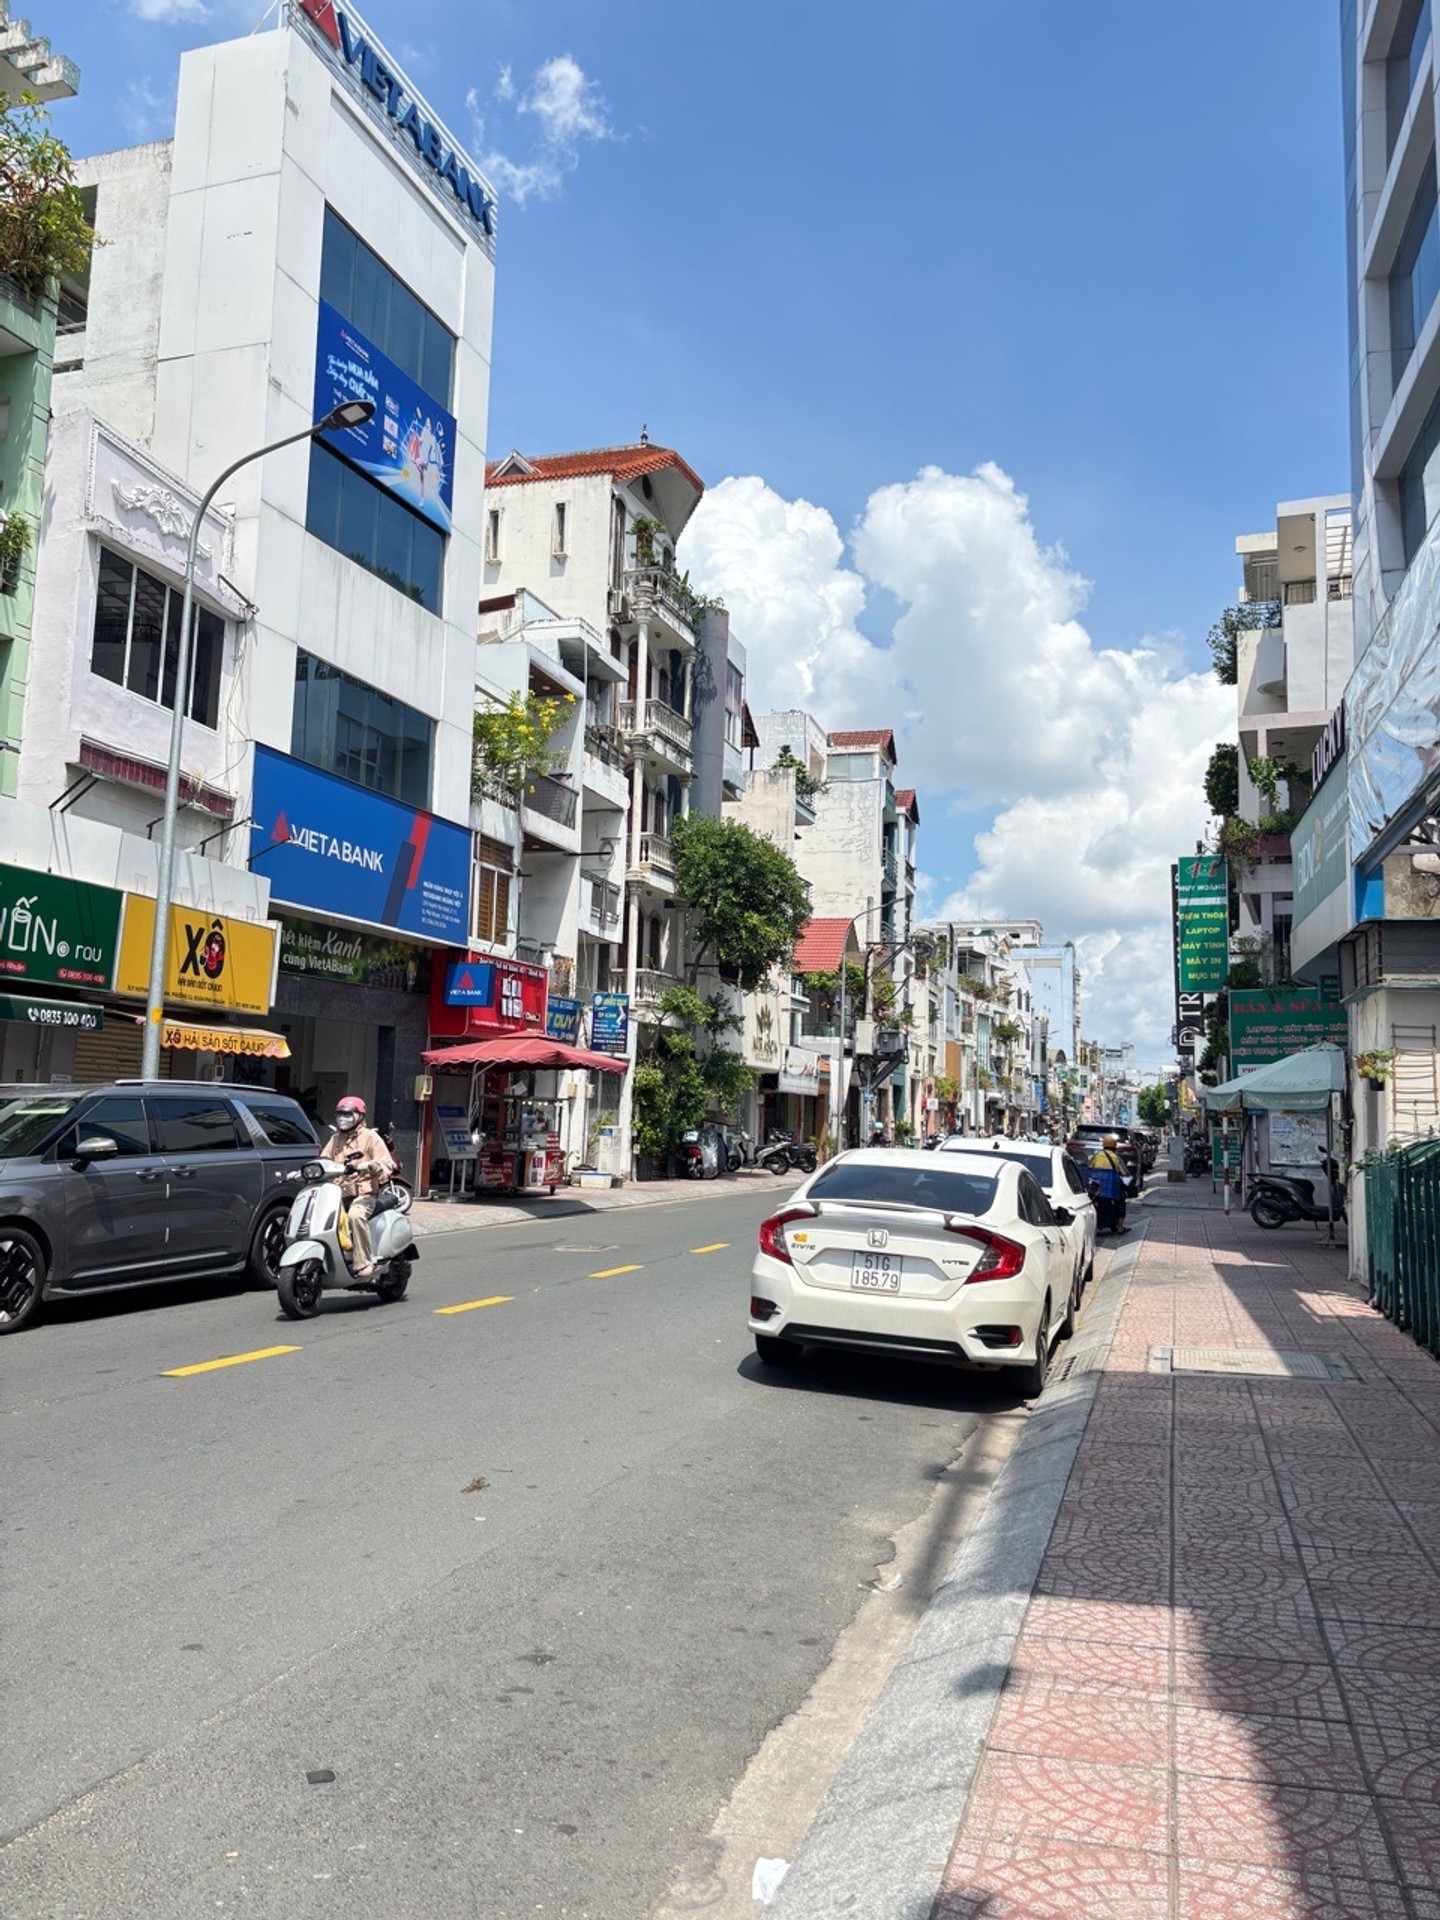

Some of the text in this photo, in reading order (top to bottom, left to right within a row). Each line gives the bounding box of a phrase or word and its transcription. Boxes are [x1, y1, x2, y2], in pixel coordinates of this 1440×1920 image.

[75, 945, 102, 962] rau
[281, 929, 362, 960] iết kiệm Xanh
[1204, 940, 1225, 949] TÍNH
[283, 951, 354, 975] cùng VietABank
[1186, 955, 1221, 965] MÁY IN
[1188, 970, 1220, 980] MỰC IN
[41, 1008, 97, 1028] 0835 100 400
[165, 1028, 181, 1044] XÔ
[222, 1035, 238, 1050] SỐT
[864, 1254, 890, 1271] 51G
[854, 1270, 899, 1289] 185.79
